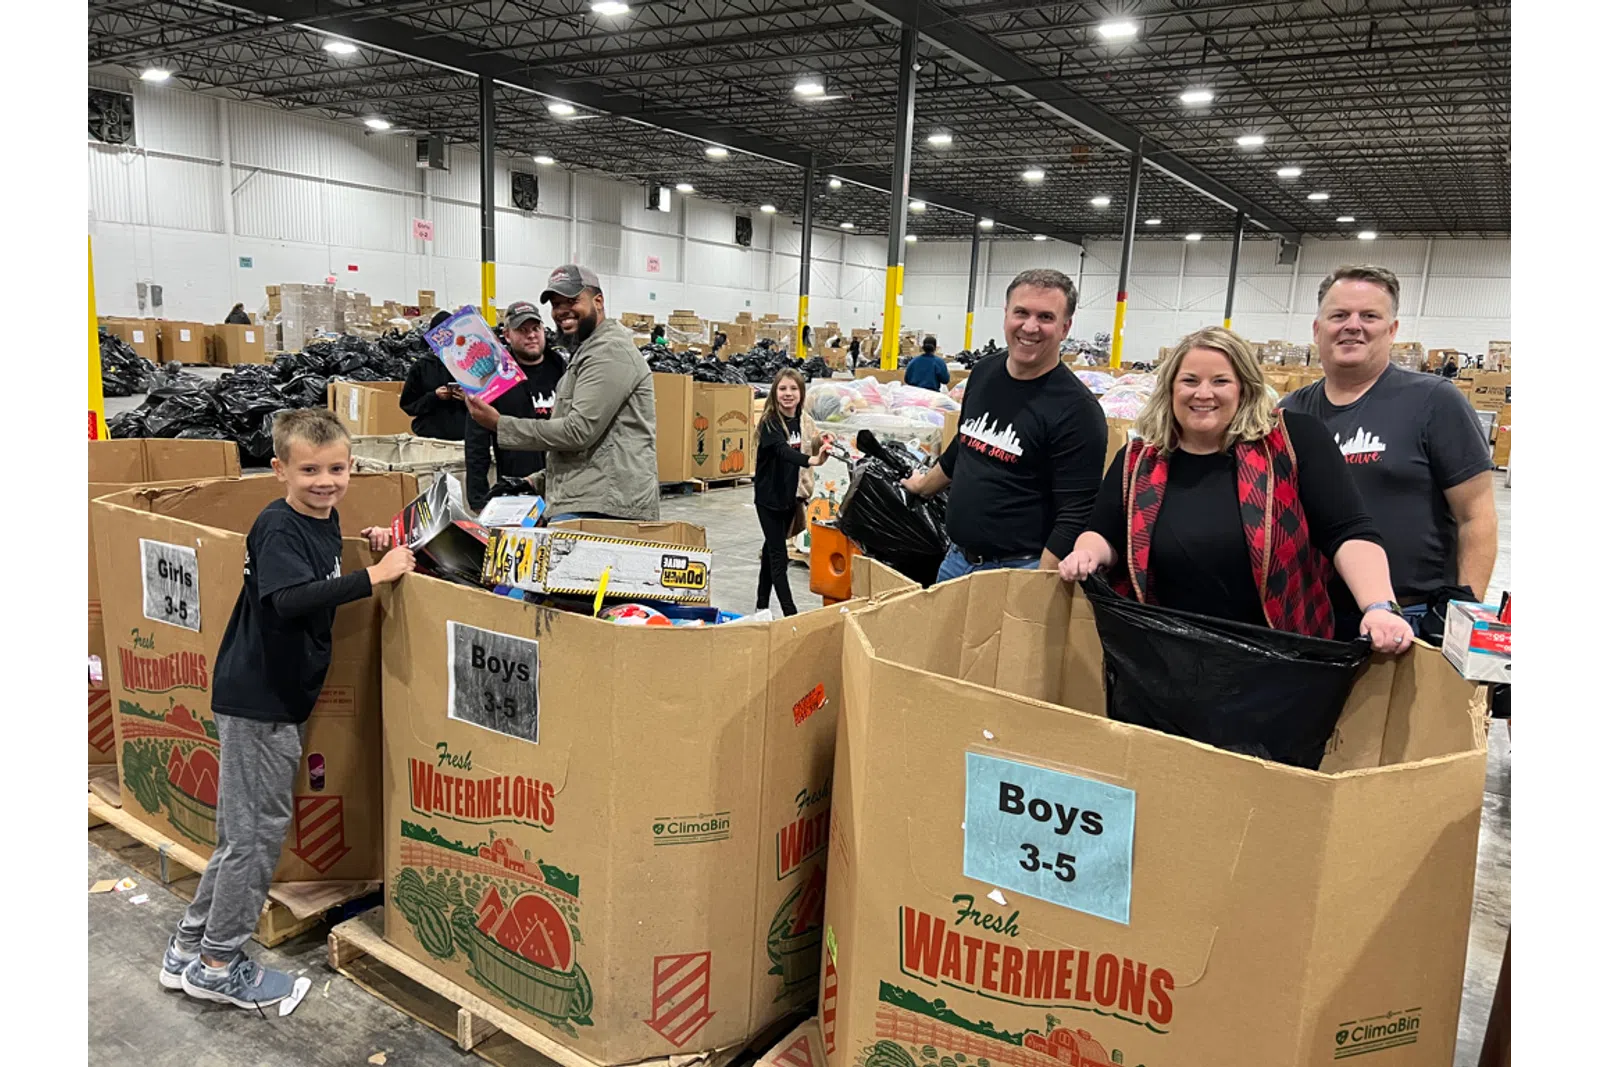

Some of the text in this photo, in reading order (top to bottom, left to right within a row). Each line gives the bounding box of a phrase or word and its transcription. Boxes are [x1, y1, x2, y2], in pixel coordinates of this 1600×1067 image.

[158, 558, 192, 588] Girls
[663, 557, 687, 569] DRIVE
[663, 570, 704, 585] POWER
[164, 596, 188, 620] 3-5
[131, 628, 155, 650] Fresh
[119, 646, 208, 690] WATERMELONS
[471, 644, 530, 683] Boys
[484, 691, 516, 718] 3-5
[435, 742, 473, 771] Fresh
[411, 758, 555, 826] WATERMELONS
[998, 781, 1104, 836] Boys
[667, 819, 730, 834] ClimaBin
[1019, 843, 1077, 883] 3-5
[952, 894, 1020, 938] Fresh
[904, 905, 1175, 1025] WATERMELONS
[1351, 1016, 1420, 1042] ClimaBin
